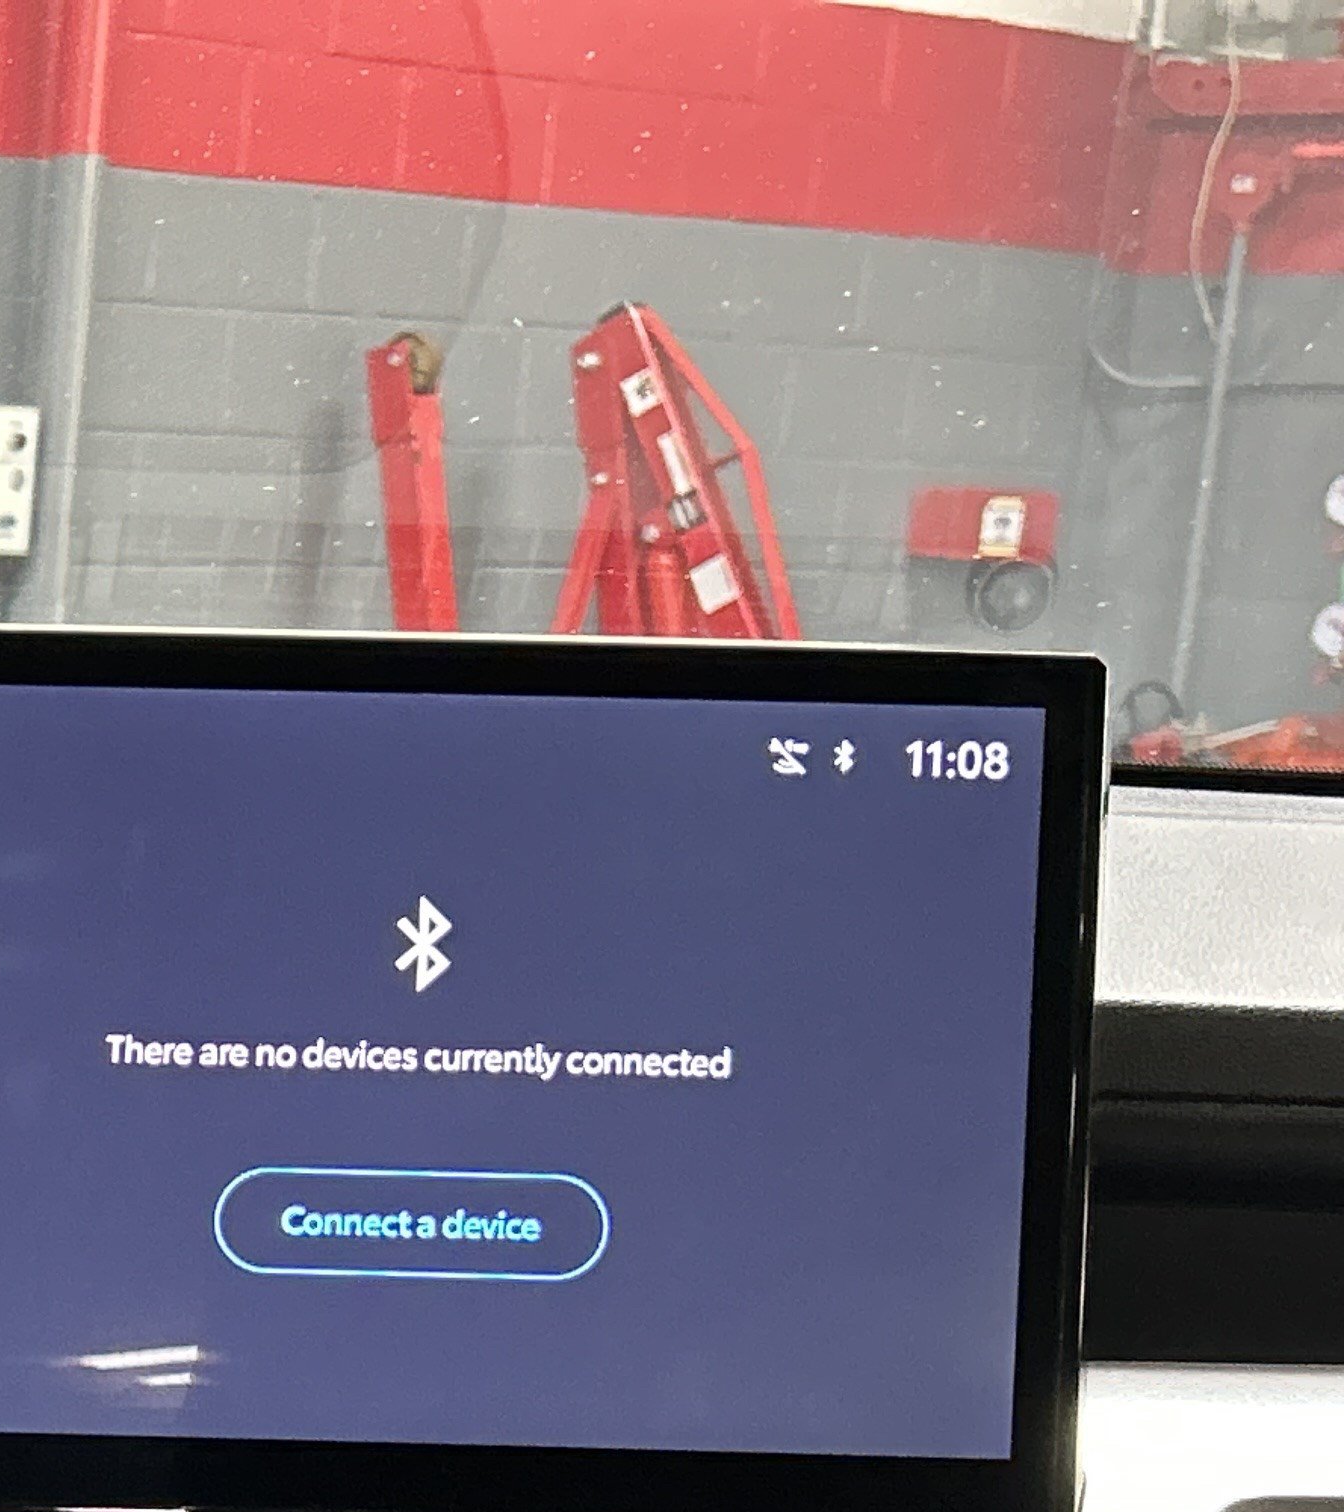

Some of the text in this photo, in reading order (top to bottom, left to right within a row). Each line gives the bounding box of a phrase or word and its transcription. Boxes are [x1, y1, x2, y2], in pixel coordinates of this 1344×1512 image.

[906, 739, 1009, 780] 11:08
[105, 1033, 732, 1081] There are no devices currently connected
[280, 1205, 542, 1243] Connect a device
